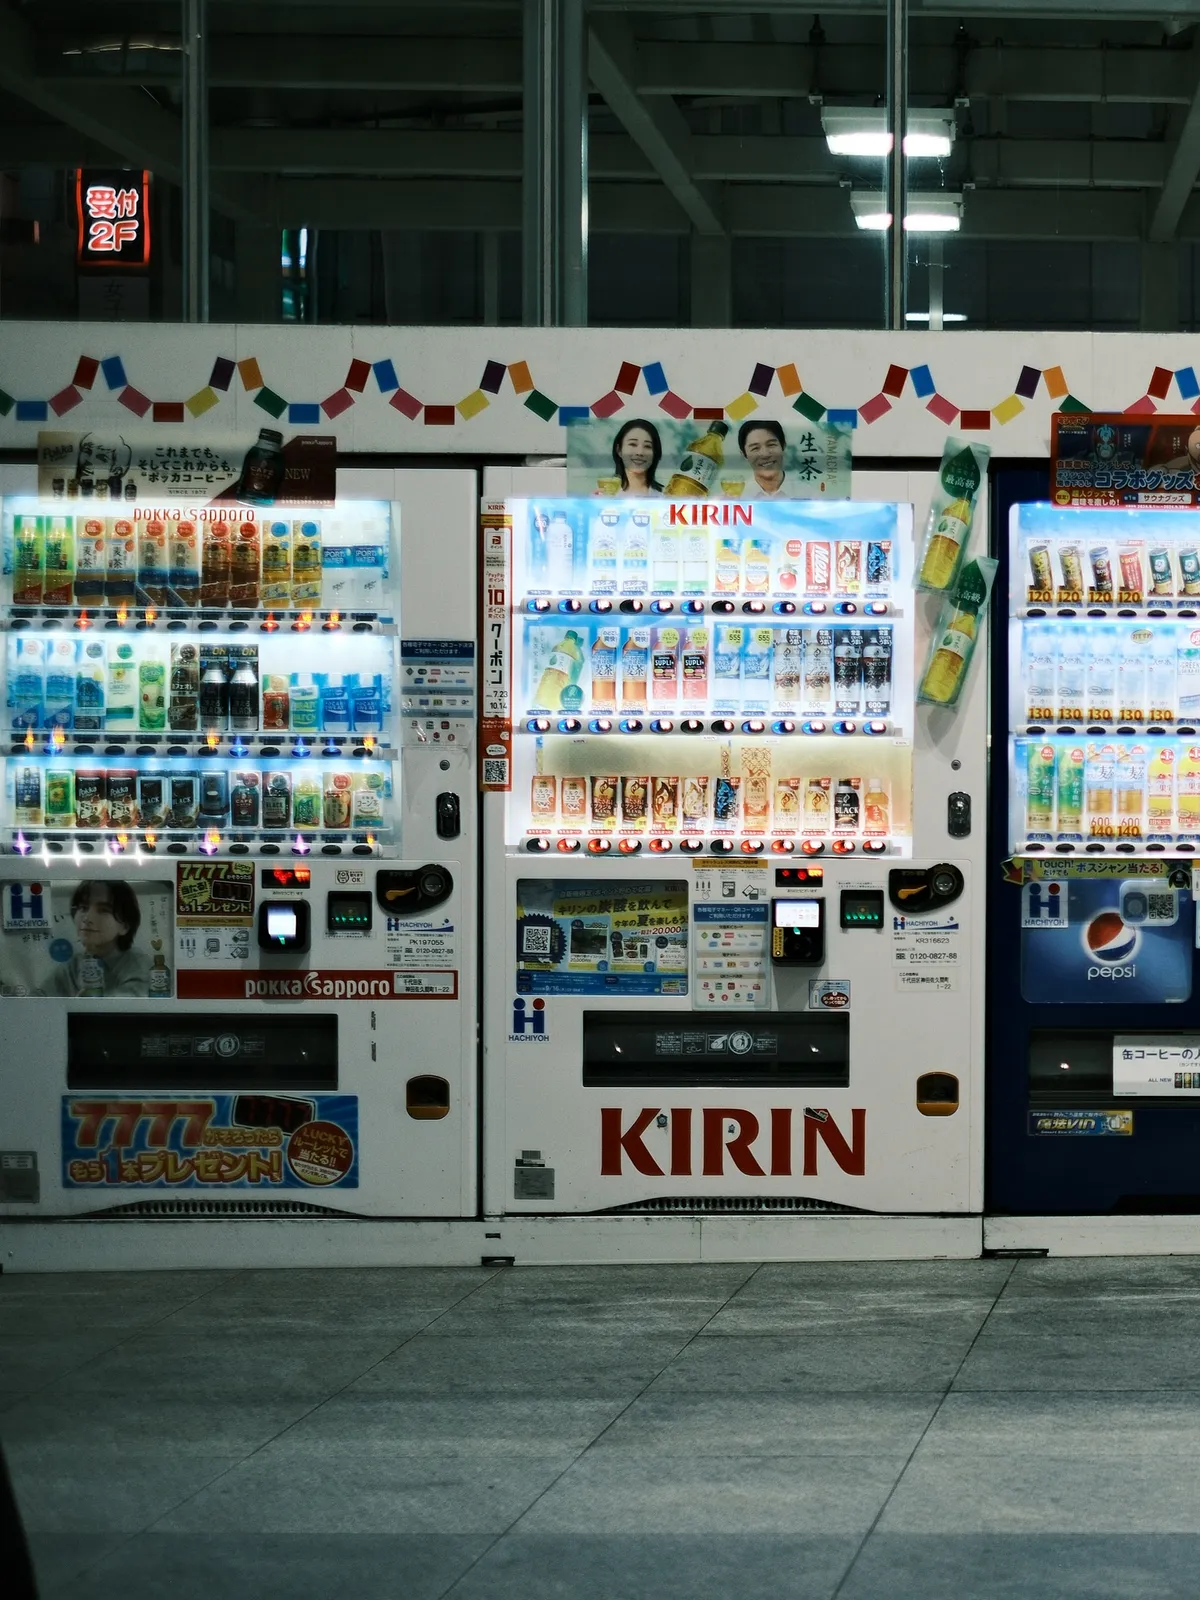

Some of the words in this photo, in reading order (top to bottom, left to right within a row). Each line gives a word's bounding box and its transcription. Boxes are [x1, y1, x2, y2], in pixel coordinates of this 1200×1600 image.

[86, 186, 139, 219] 受付
[88, 220, 139, 251] 2F
[155, 447, 220, 459] これまでも、
[799, 432, 823, 481] 生茶
[137, 459, 238, 471] そしてこれからも。
[285, 468, 310, 480] NEW
[1144, 495, 1185, 503] サウナグッズ
[134, 508, 180, 523] pokka
[190, 508, 255, 522] sapporo
[669, 504, 753, 527] KIRIN
[82, 545, 93, 569] 麦茶
[112, 545, 123, 569] 麦茶
[488, 589, 505, 605] 10
[1028, 591, 1050, 602] 120
[1058, 591, 1080, 602] 120
[1089, 591, 1111, 602] 120
[1118, 591, 1140, 602] 120
[493, 690, 508, 698] 7.23
[490, 702, 507, 710] 10.14
[1029, 708, 1051, 719] 130
[1058, 708, 1081, 719] 130
[1089, 708, 1111, 719] 130
[1120, 708, 1142, 720] 130
[1150, 708, 1172, 720] 130
[835, 806, 859, 814] BLACK
[1091, 826, 1113, 836] 140
[1117, 826, 1140, 836] 140
[1038, 859, 1074, 869] Touch!
[1076, 863, 1163, 875] ボスジャン当たる!
[179, 863, 229, 880] 7777
[179, 902, 252, 913] もう1本プレゼント!
[1087, 964, 1136, 981] pepsi
[245, 979, 302, 998] pokka
[311, 978, 390, 998] sapporo
[508, 1034, 550, 1042] HACHIYOH
[71, 1102, 217, 1147] 7777
[302, 1127, 349, 1146] LUCKY
[600, 1107, 867, 1177] KIRIN
[298, 1149, 337, 1167] 当たる!!
[70, 1147, 282, 1184] もう1本プレゼント!
